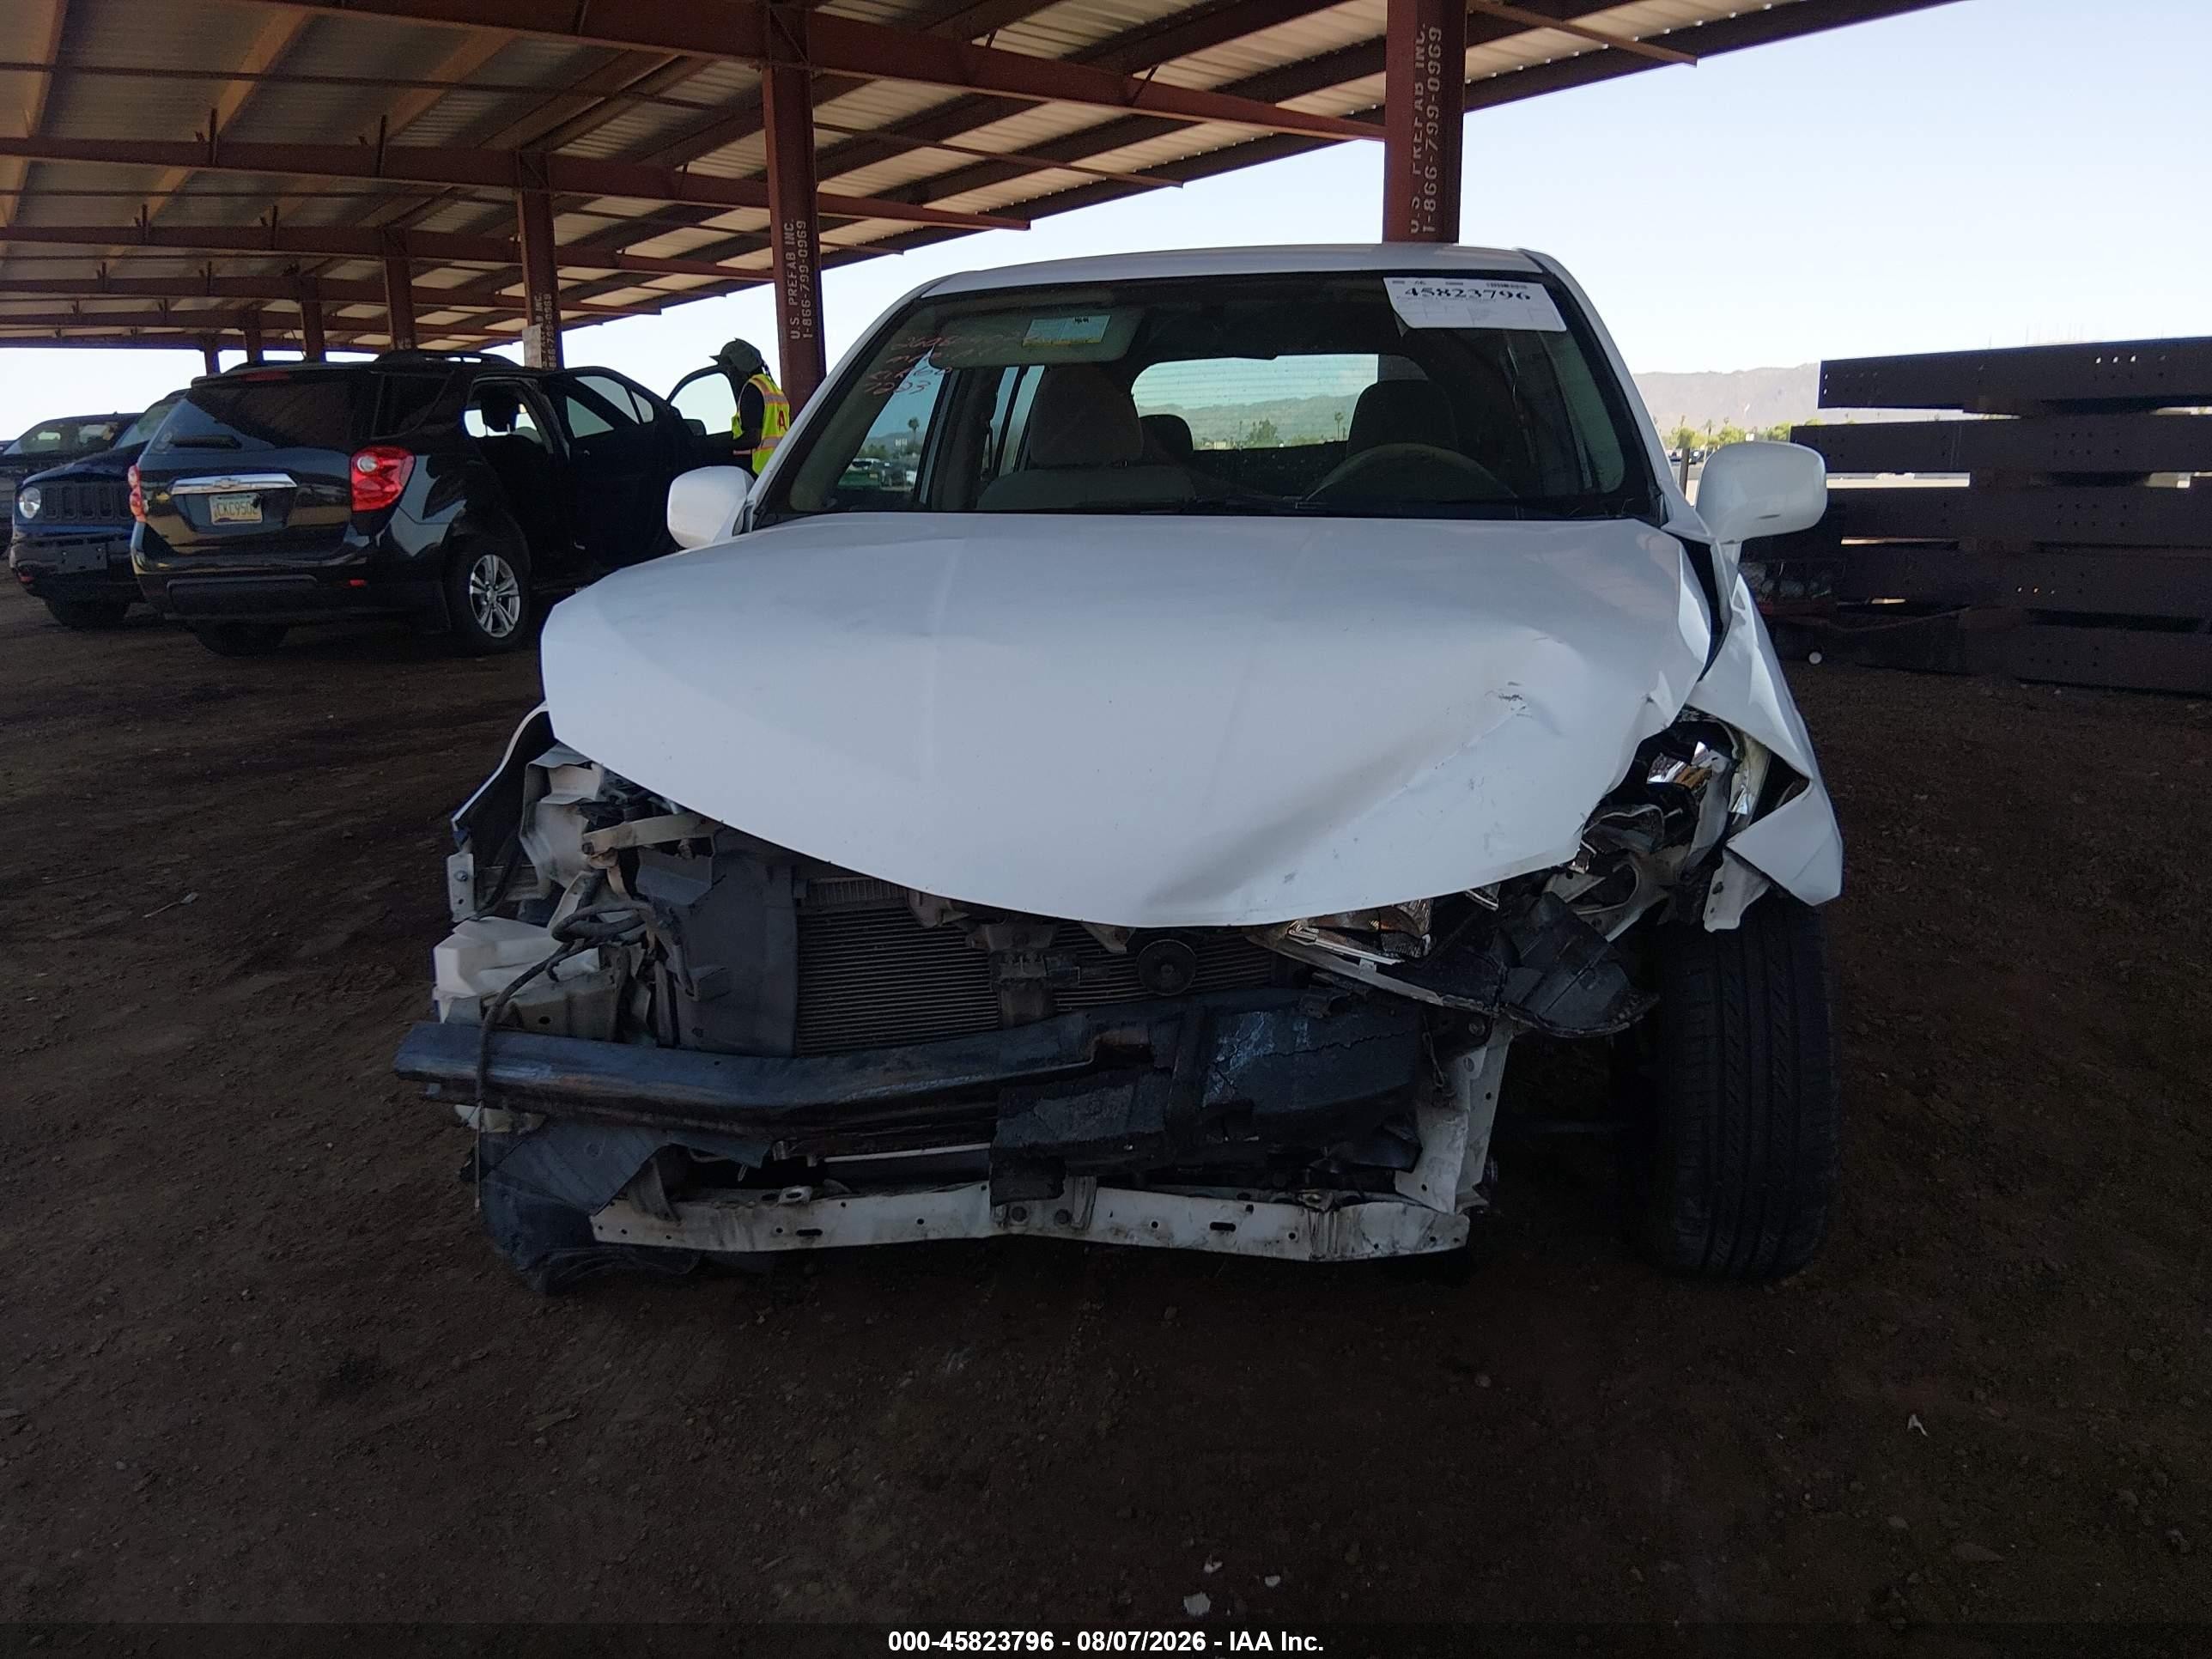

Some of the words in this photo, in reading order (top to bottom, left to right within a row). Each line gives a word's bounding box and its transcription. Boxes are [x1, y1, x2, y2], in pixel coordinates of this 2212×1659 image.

[1422, 27, 1443, 233] 1-866-799-0969
[784, 219, 795, 246] INC.
[785, 252, 799, 306] PREFAB
[796, 220, 813, 338] 1-866-799-0969
[1405, 287, 1531, 301] 45823796
[790, 313, 801, 340] U.S.
